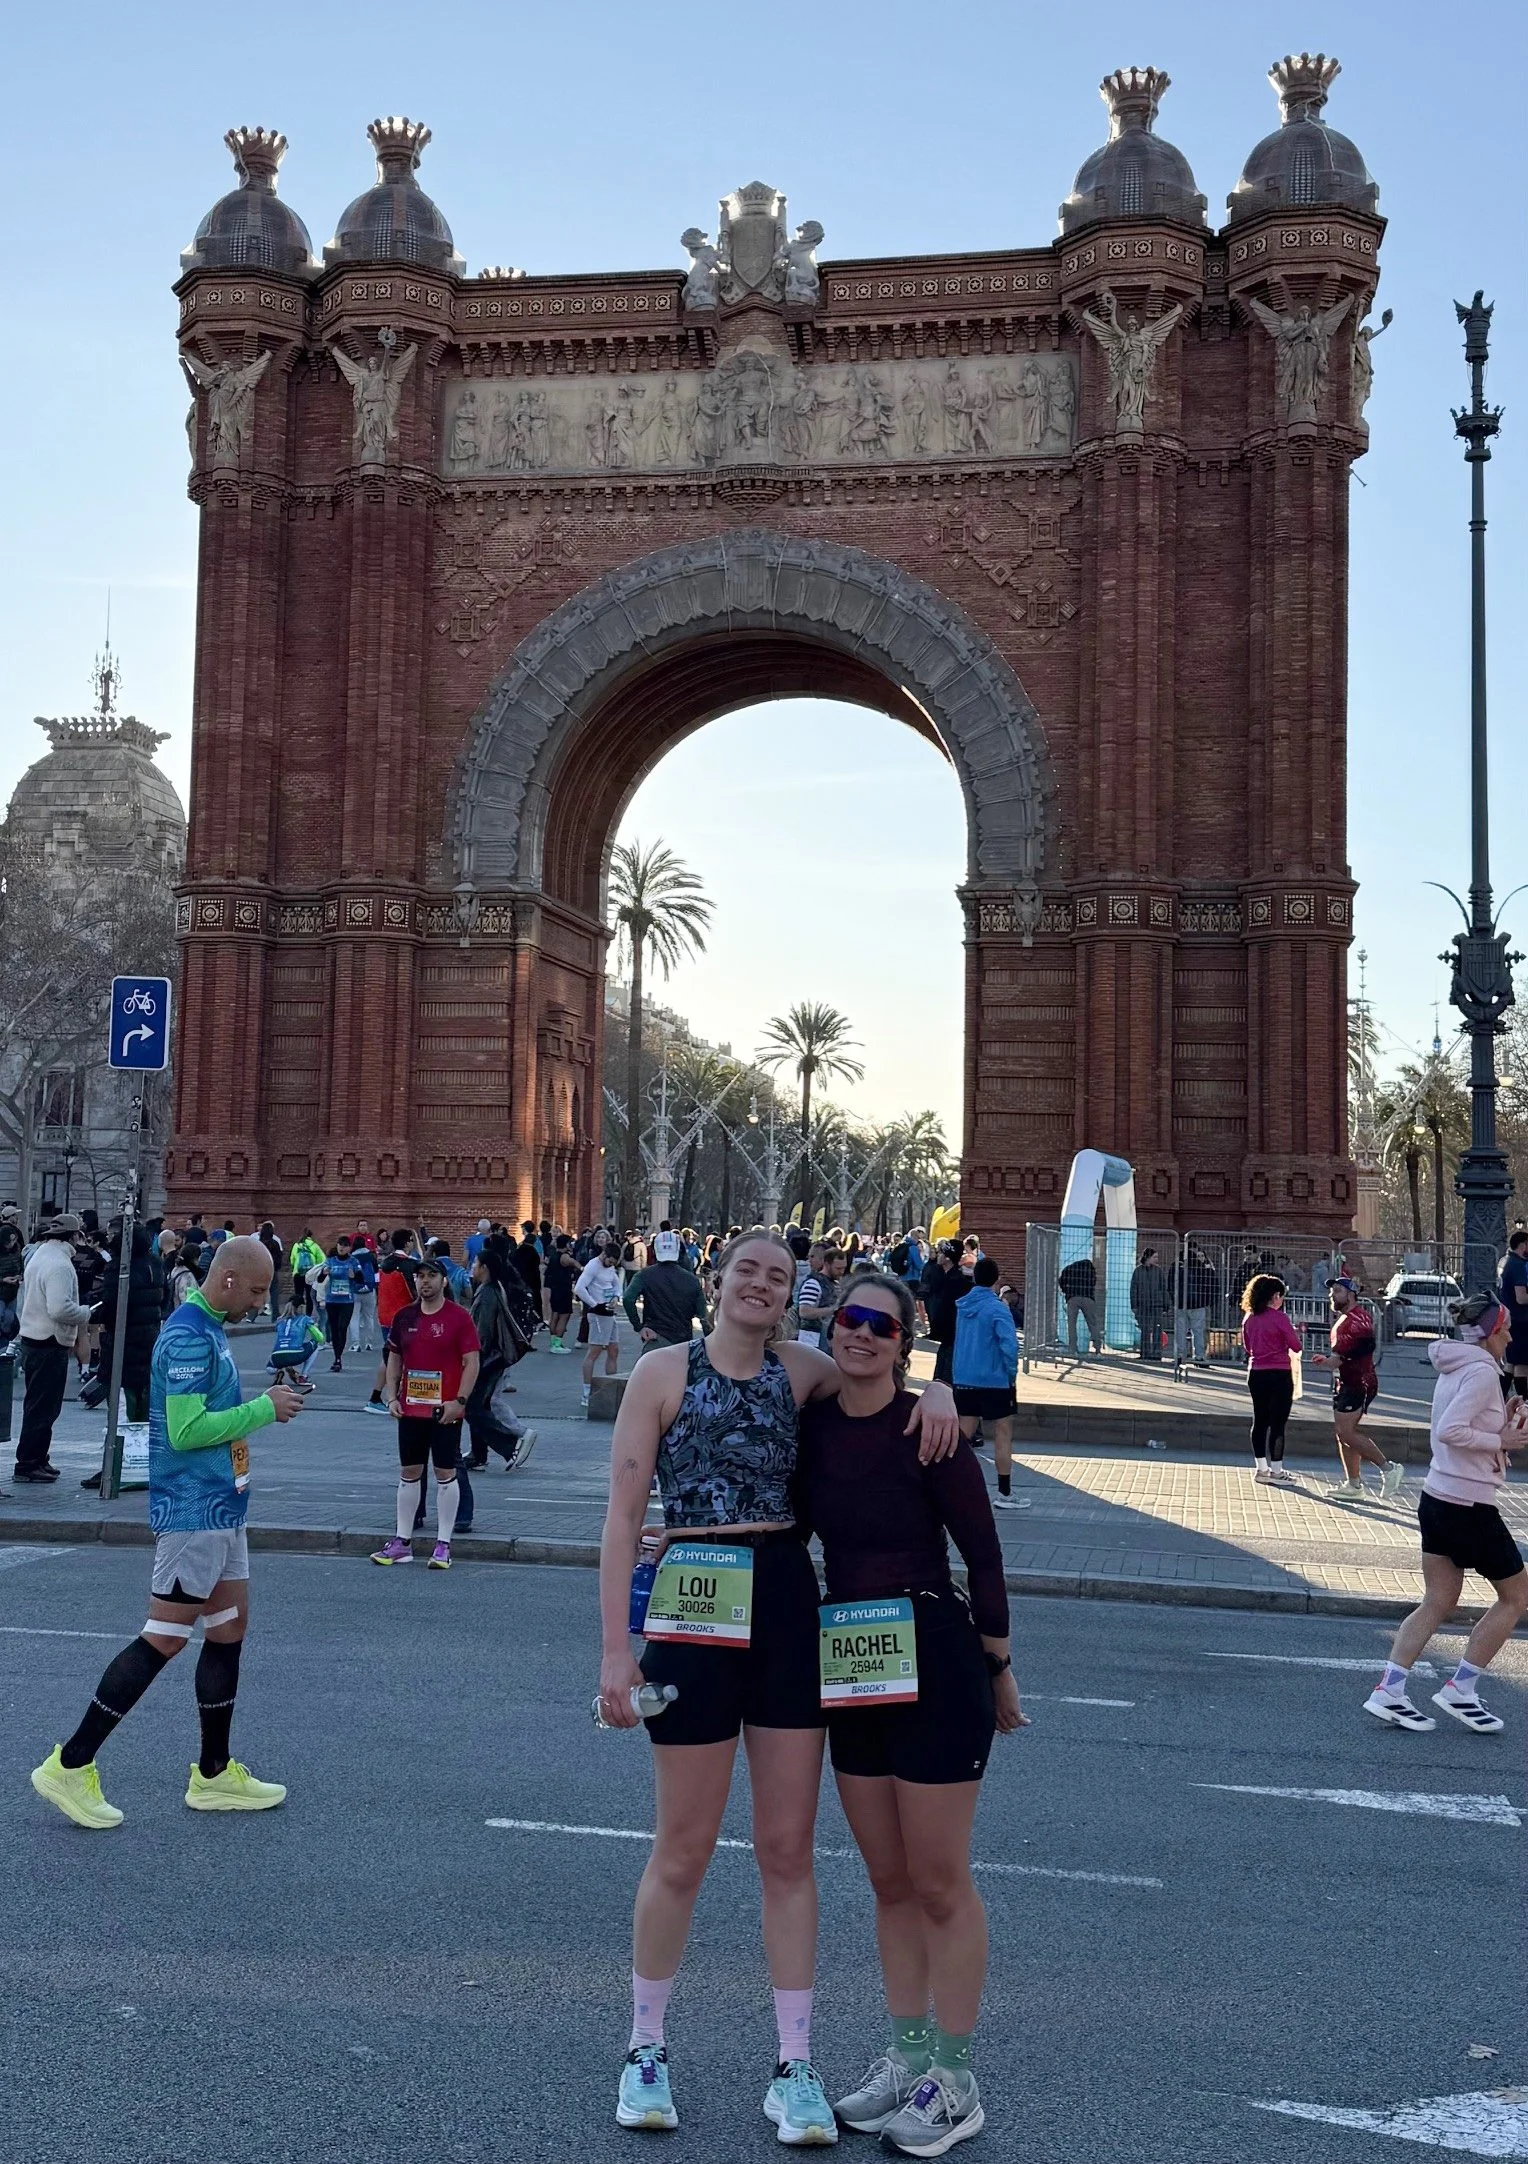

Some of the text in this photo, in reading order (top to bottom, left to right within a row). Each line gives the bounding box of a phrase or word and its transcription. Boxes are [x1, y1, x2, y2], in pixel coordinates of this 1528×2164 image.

[686, 1551, 737, 1563] HYUNDAI
[678, 1575, 717, 1598] LOU
[678, 1600, 715, 1614] 30026
[850, 1607, 899, 1619] HYUNDAI
[676, 1623, 716, 1634] BROOKS
[832, 1633, 903, 1659] RACHEL
[850, 1659, 885, 1674] 25944
[851, 1683, 887, 1695] BROOKS
